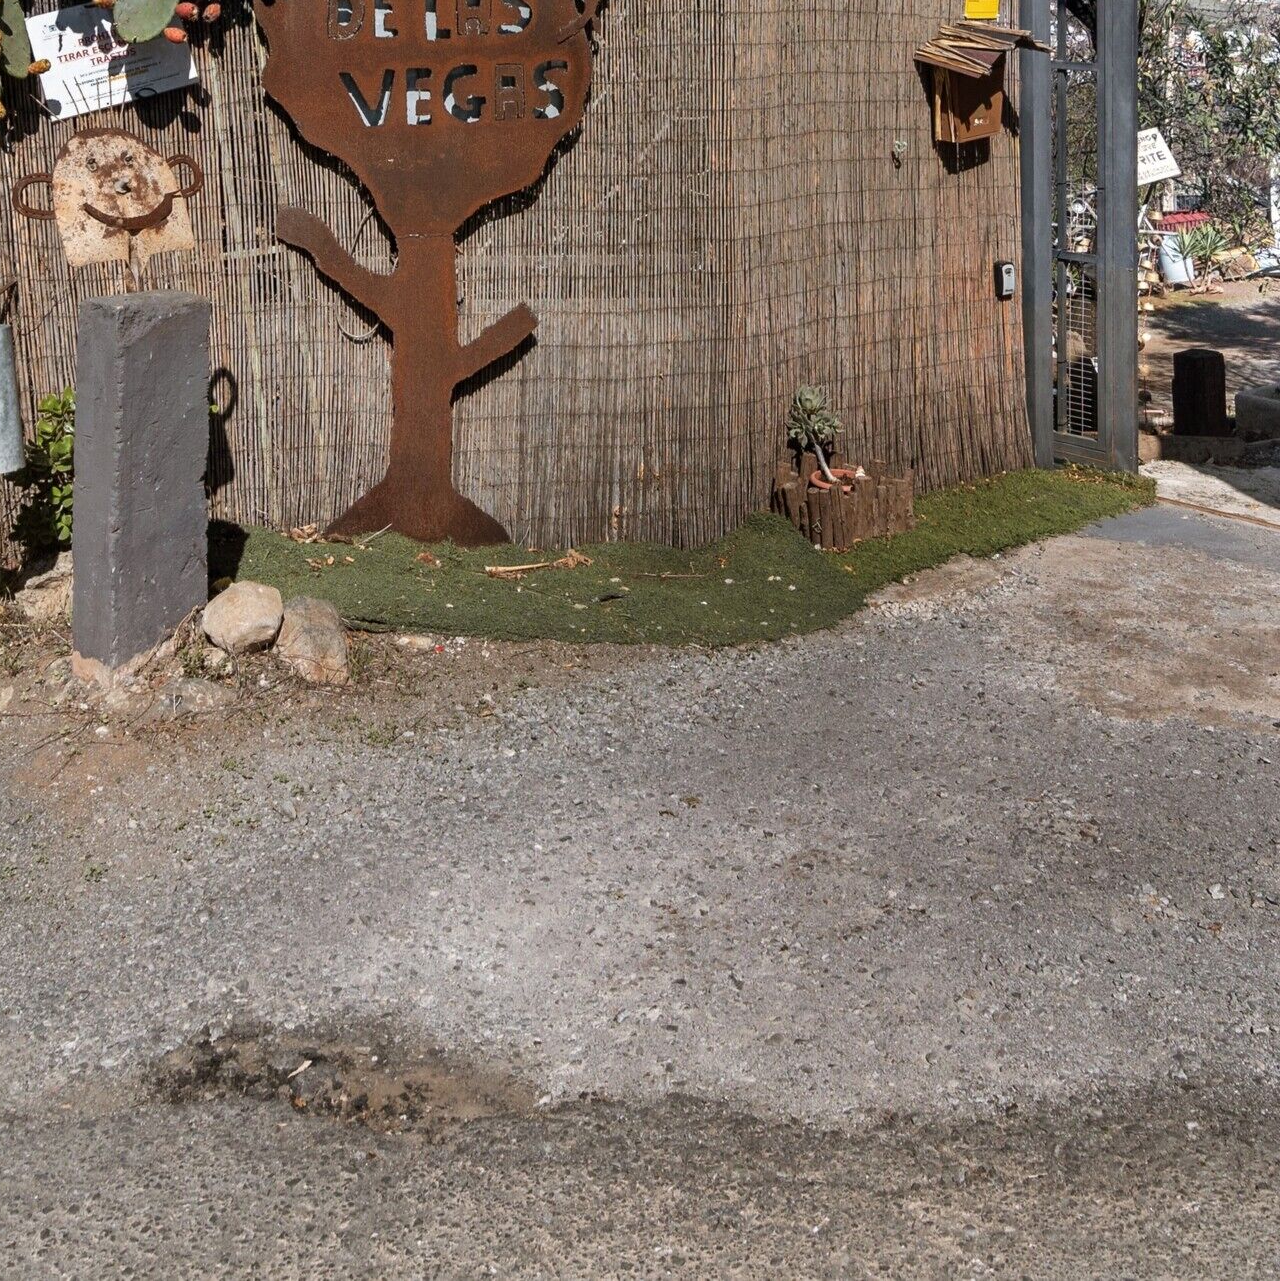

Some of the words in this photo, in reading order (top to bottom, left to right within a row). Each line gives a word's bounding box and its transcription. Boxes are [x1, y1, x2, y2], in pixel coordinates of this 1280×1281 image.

[57, 47, 90, 64] TIRAR
[90, 47, 138, 67] TRASTOS
[339, 60, 569, 127] VEGAS
